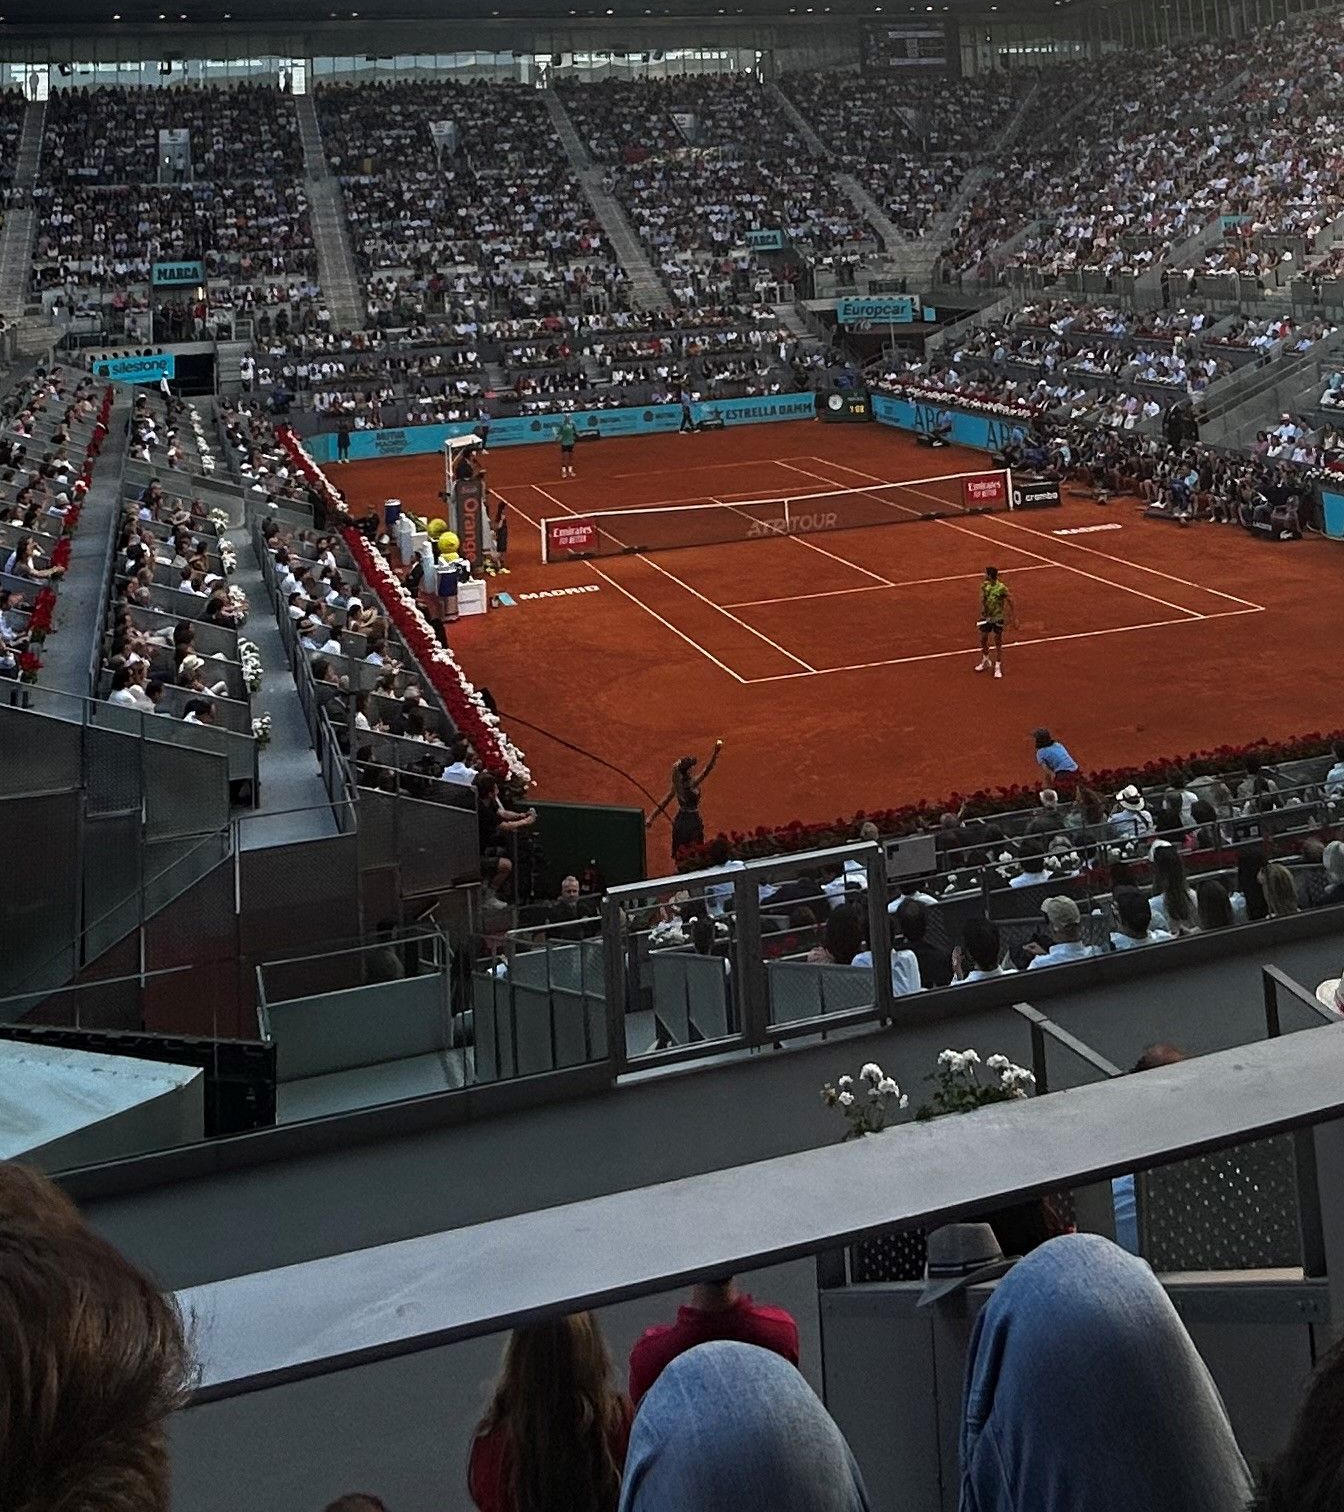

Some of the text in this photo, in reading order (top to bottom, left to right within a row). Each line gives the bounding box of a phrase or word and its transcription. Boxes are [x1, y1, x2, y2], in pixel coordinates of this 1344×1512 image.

[842, 303, 908, 318] Europcar
[725, 402, 812, 420] ESTRELLA DAMM
[790, 512, 838, 530] TOUR
[463, 498, 479, 563] Orange
[553, 525, 592, 538] Emirates
[519, 585, 600, 601] MADRID
